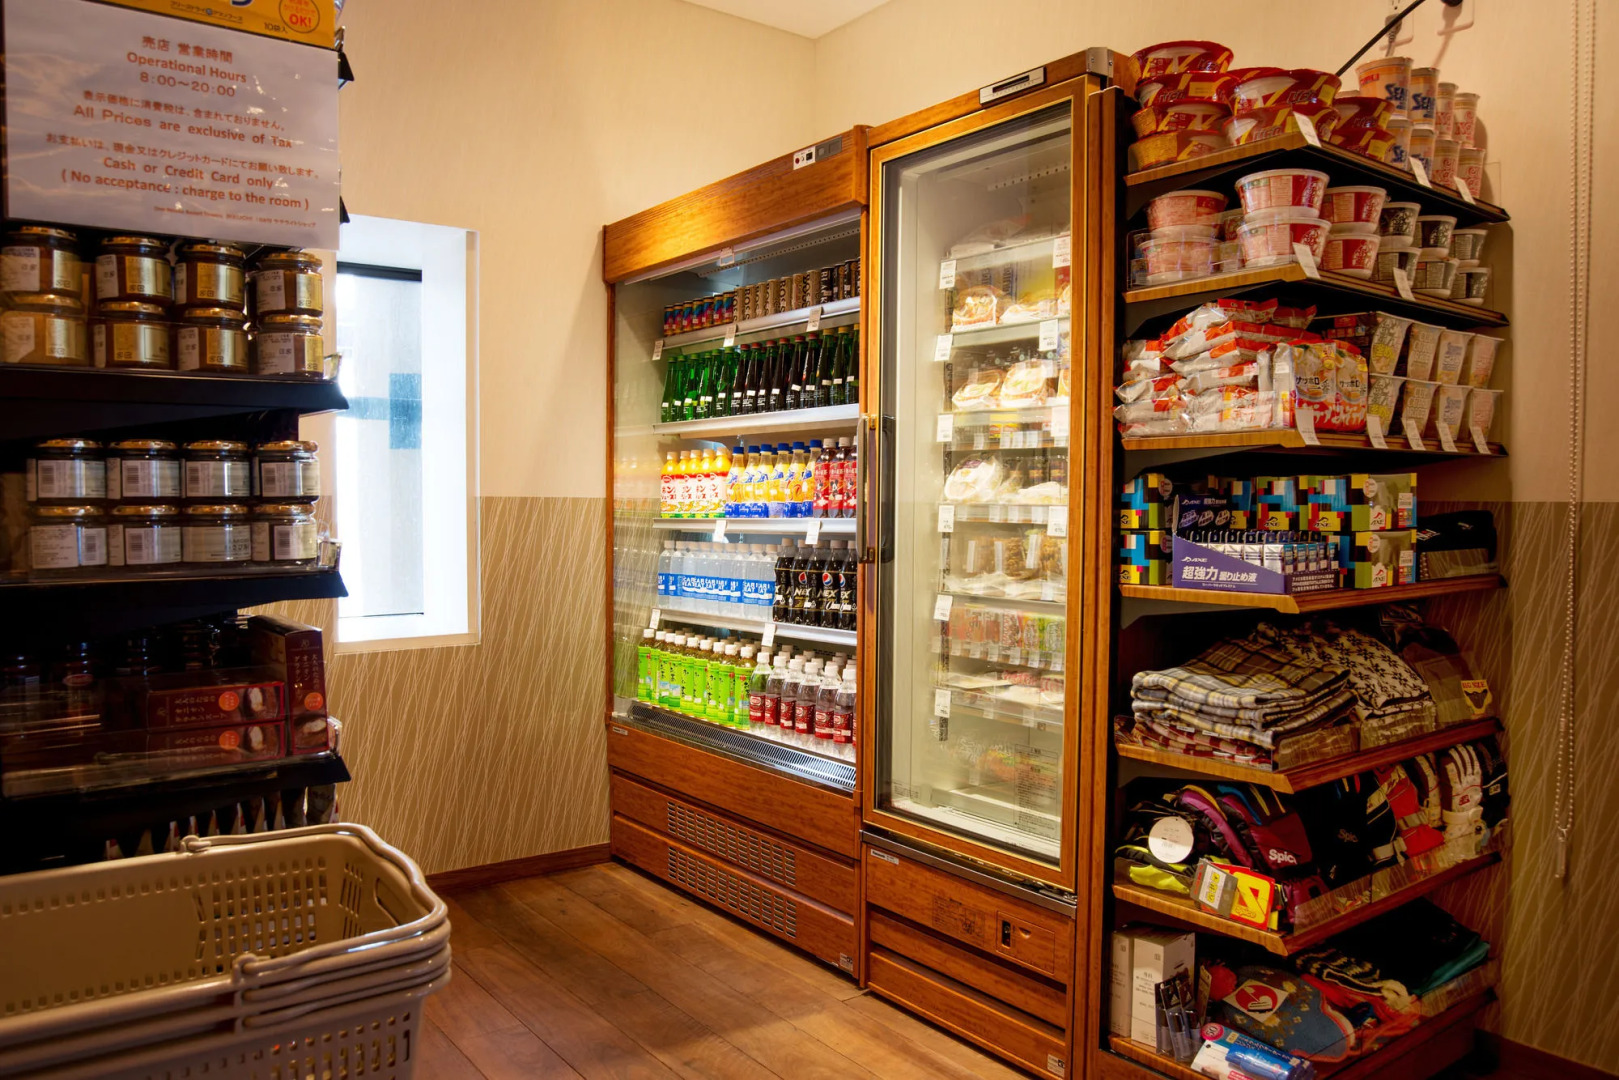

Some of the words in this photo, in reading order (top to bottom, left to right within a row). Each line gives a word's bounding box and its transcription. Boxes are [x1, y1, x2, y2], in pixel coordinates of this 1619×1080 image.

[289, 13, 312, 28] OK!
[142, 36, 170, 52] 売店
[177, 42, 233, 64] 営業時間
[127, 51, 206, 75] Operational
[209, 66, 246, 83] Hours
[73, 104, 94, 119] All
[101, 109, 152, 127] Prices
[159, 121, 181, 132] are
[188, 124, 245, 142] exclusive
[252, 133, 265, 144] of
[270, 136, 293, 148] Tax
[103, 156, 137, 171] Cash
[143, 163, 158, 173] or
[165, 164, 204, 180] Credit
[211, 170, 240, 184] Card
[247, 176, 273, 190] only
[95, 175, 171, 193] acceptance
[182, 185, 225, 202] charge
[229, 190, 242, 201] to
[245, 191, 266, 204] the
[269, 197, 301, 208] room
[1181, 565, 1219, 581] 超強力
